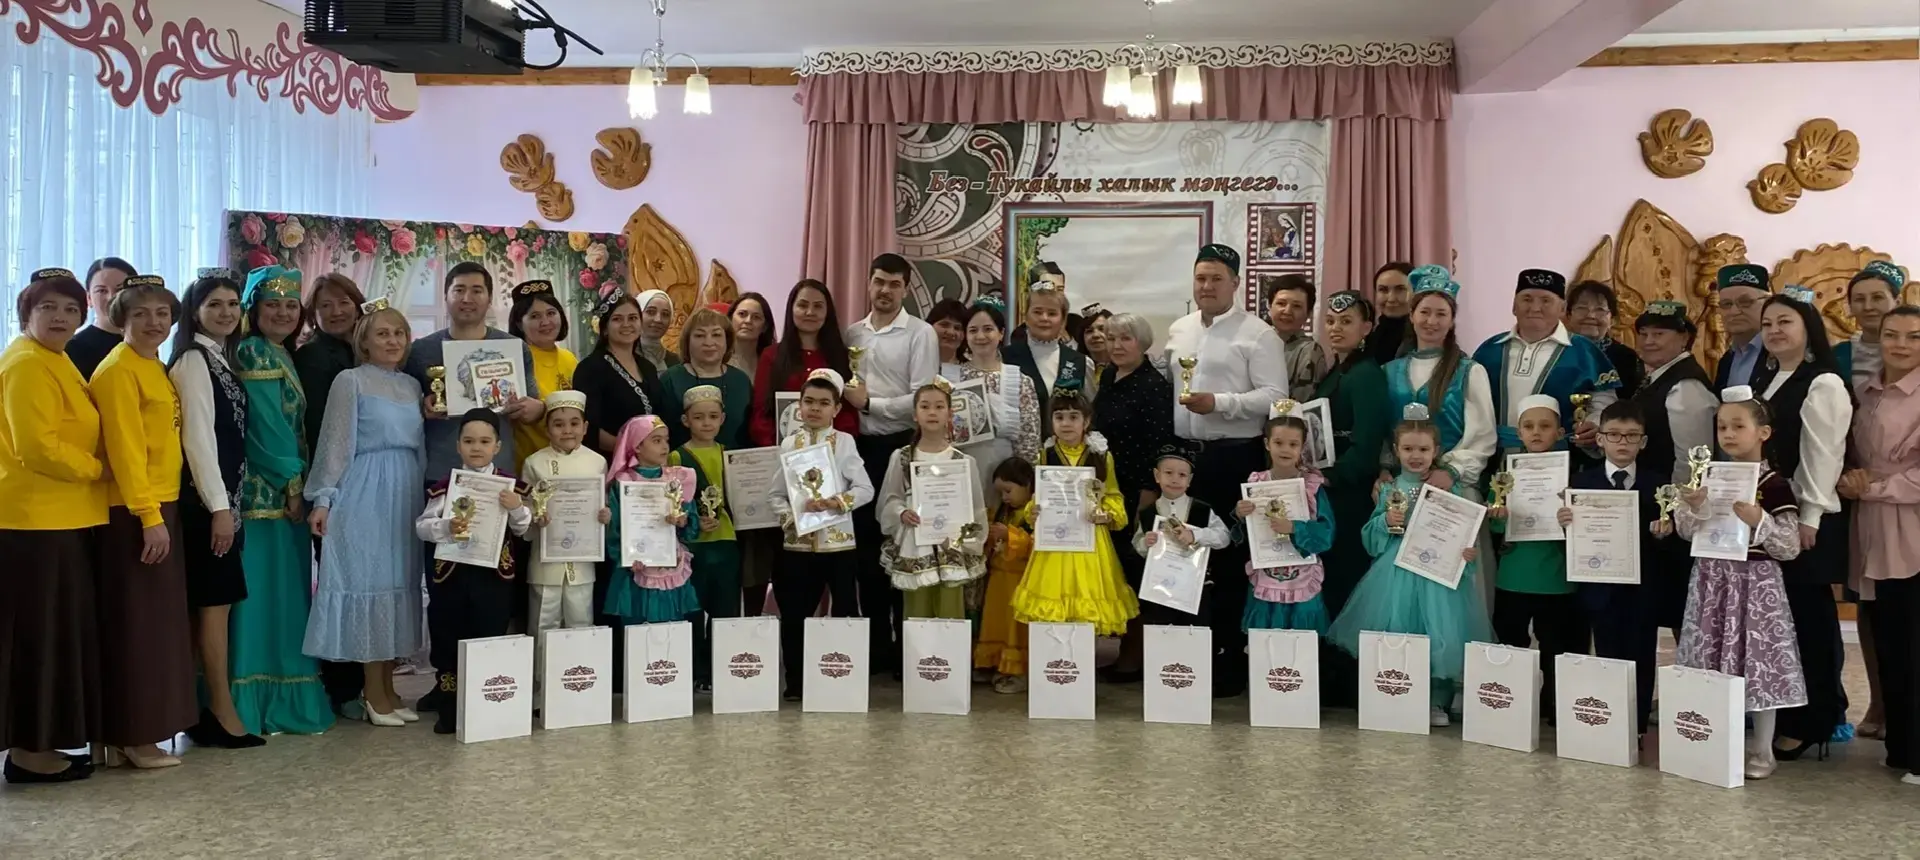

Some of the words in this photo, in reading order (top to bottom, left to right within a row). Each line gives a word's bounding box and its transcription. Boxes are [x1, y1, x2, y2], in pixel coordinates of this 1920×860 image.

[927, 170, 969, 194] Без
[987, 171, 1092, 198] Тукайлы
[1096, 176, 1176, 193] халык
[1180, 176, 1299, 196] мәңгегә...
